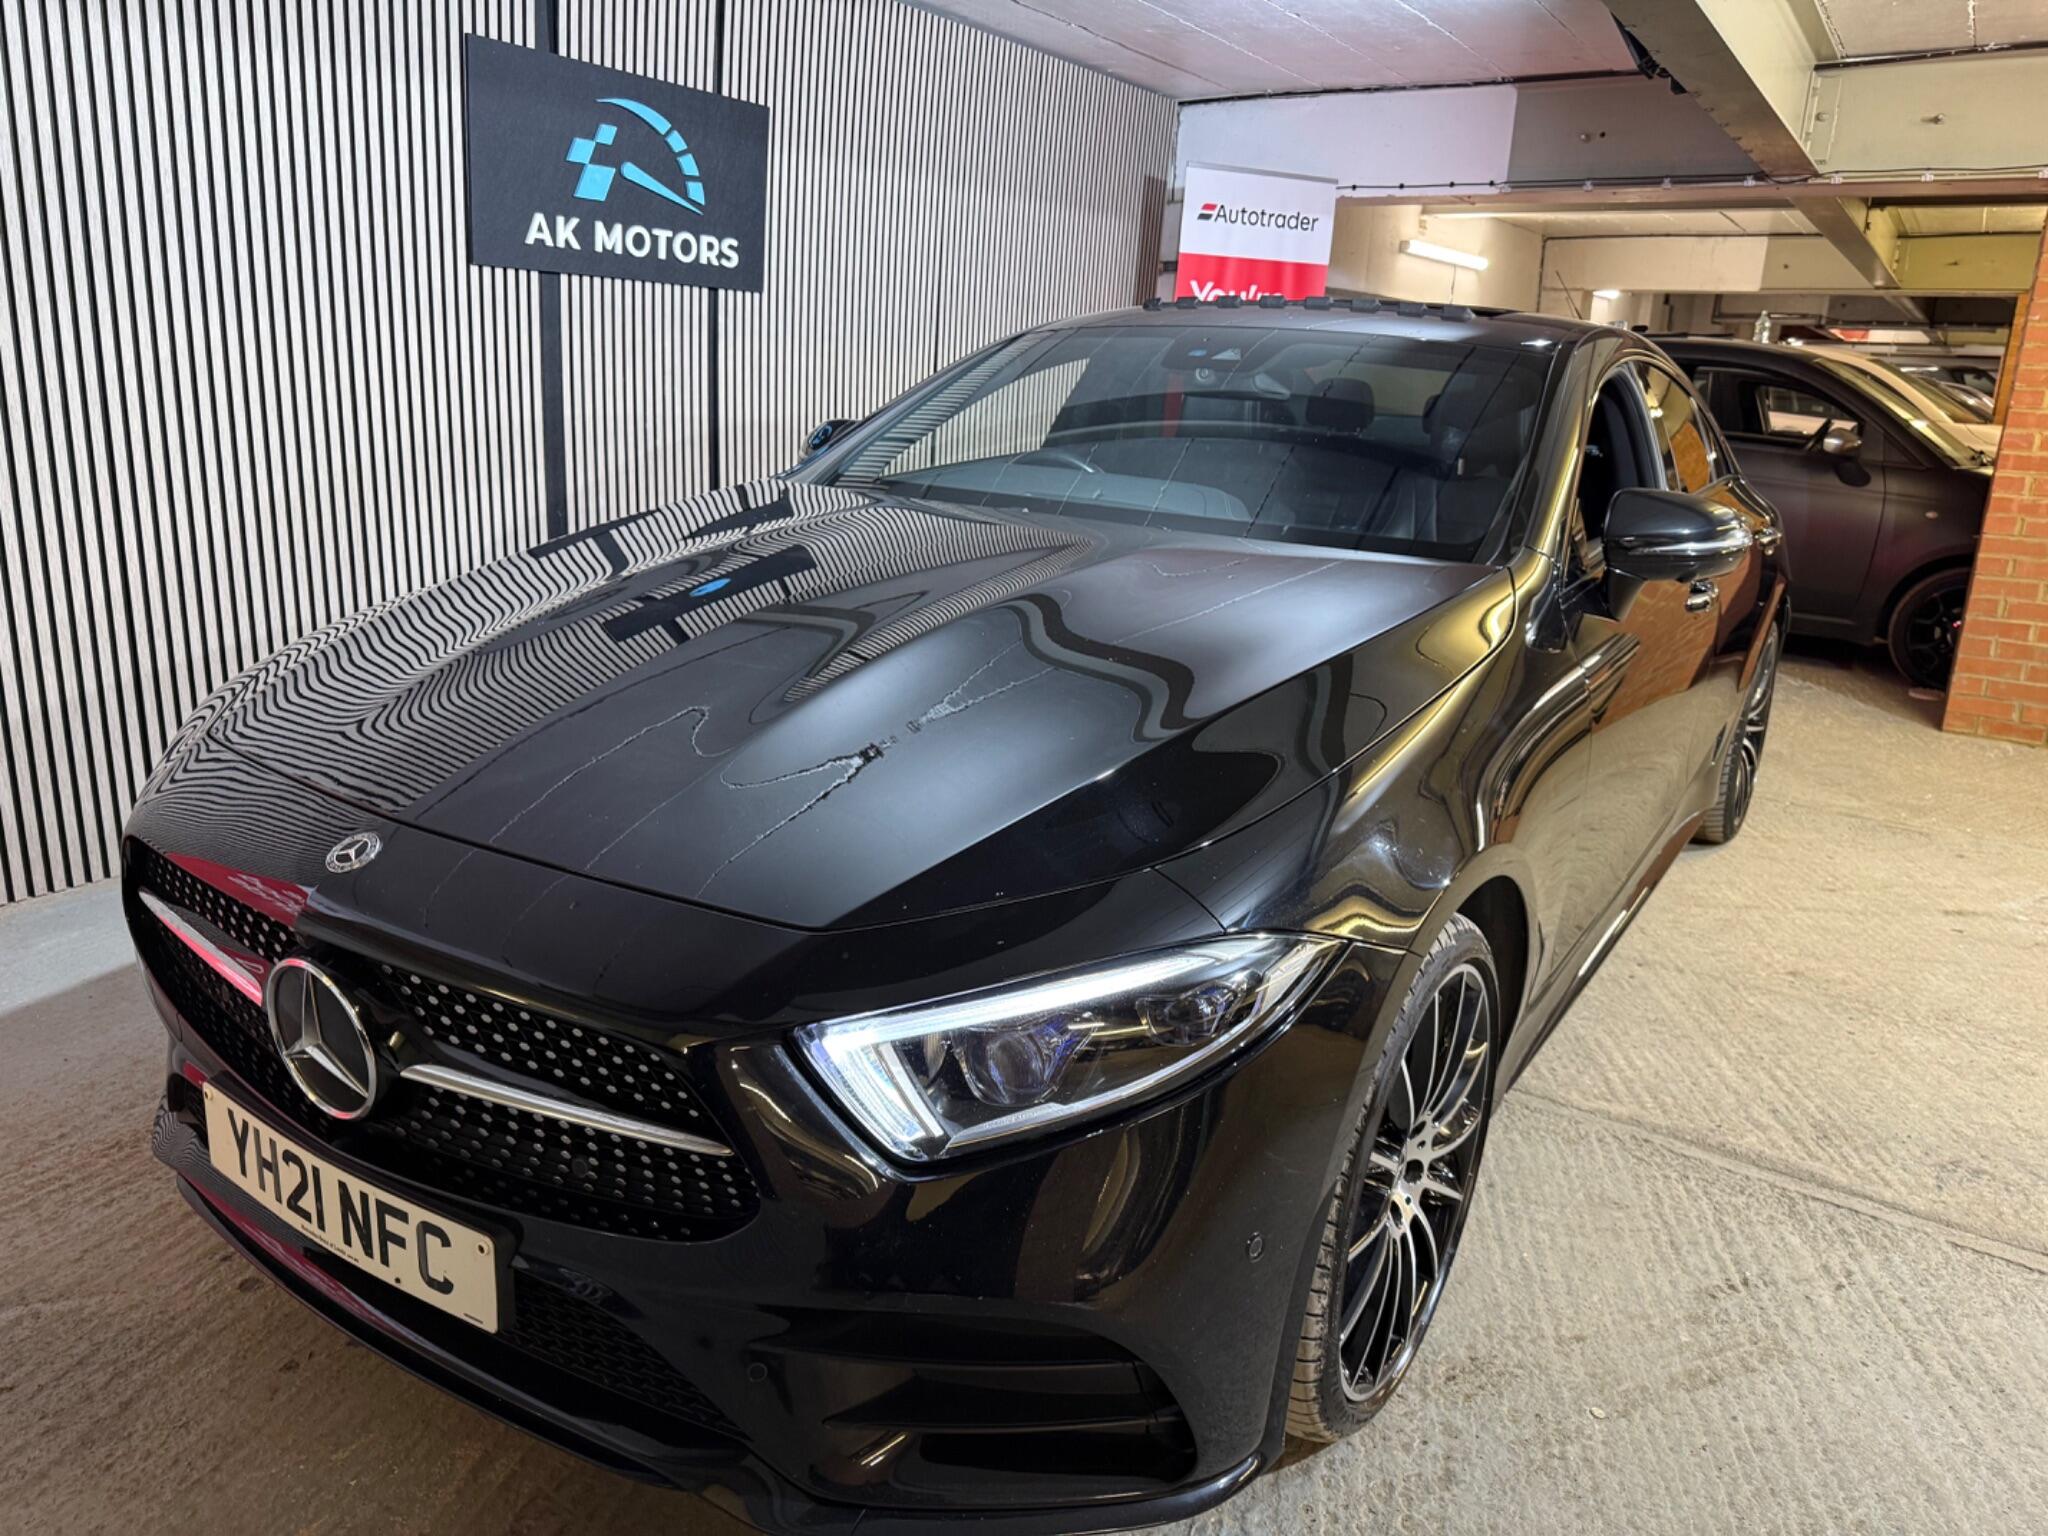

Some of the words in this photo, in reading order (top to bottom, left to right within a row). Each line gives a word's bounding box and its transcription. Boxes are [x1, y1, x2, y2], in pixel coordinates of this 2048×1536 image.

[524, 211, 581, 250] AK
[594, 219, 740, 268] MOTORS
[1214, 204, 1319, 231] Autotrader
[227, 1108, 326, 1233] YH21
[337, 1178, 454, 1296] NFC
